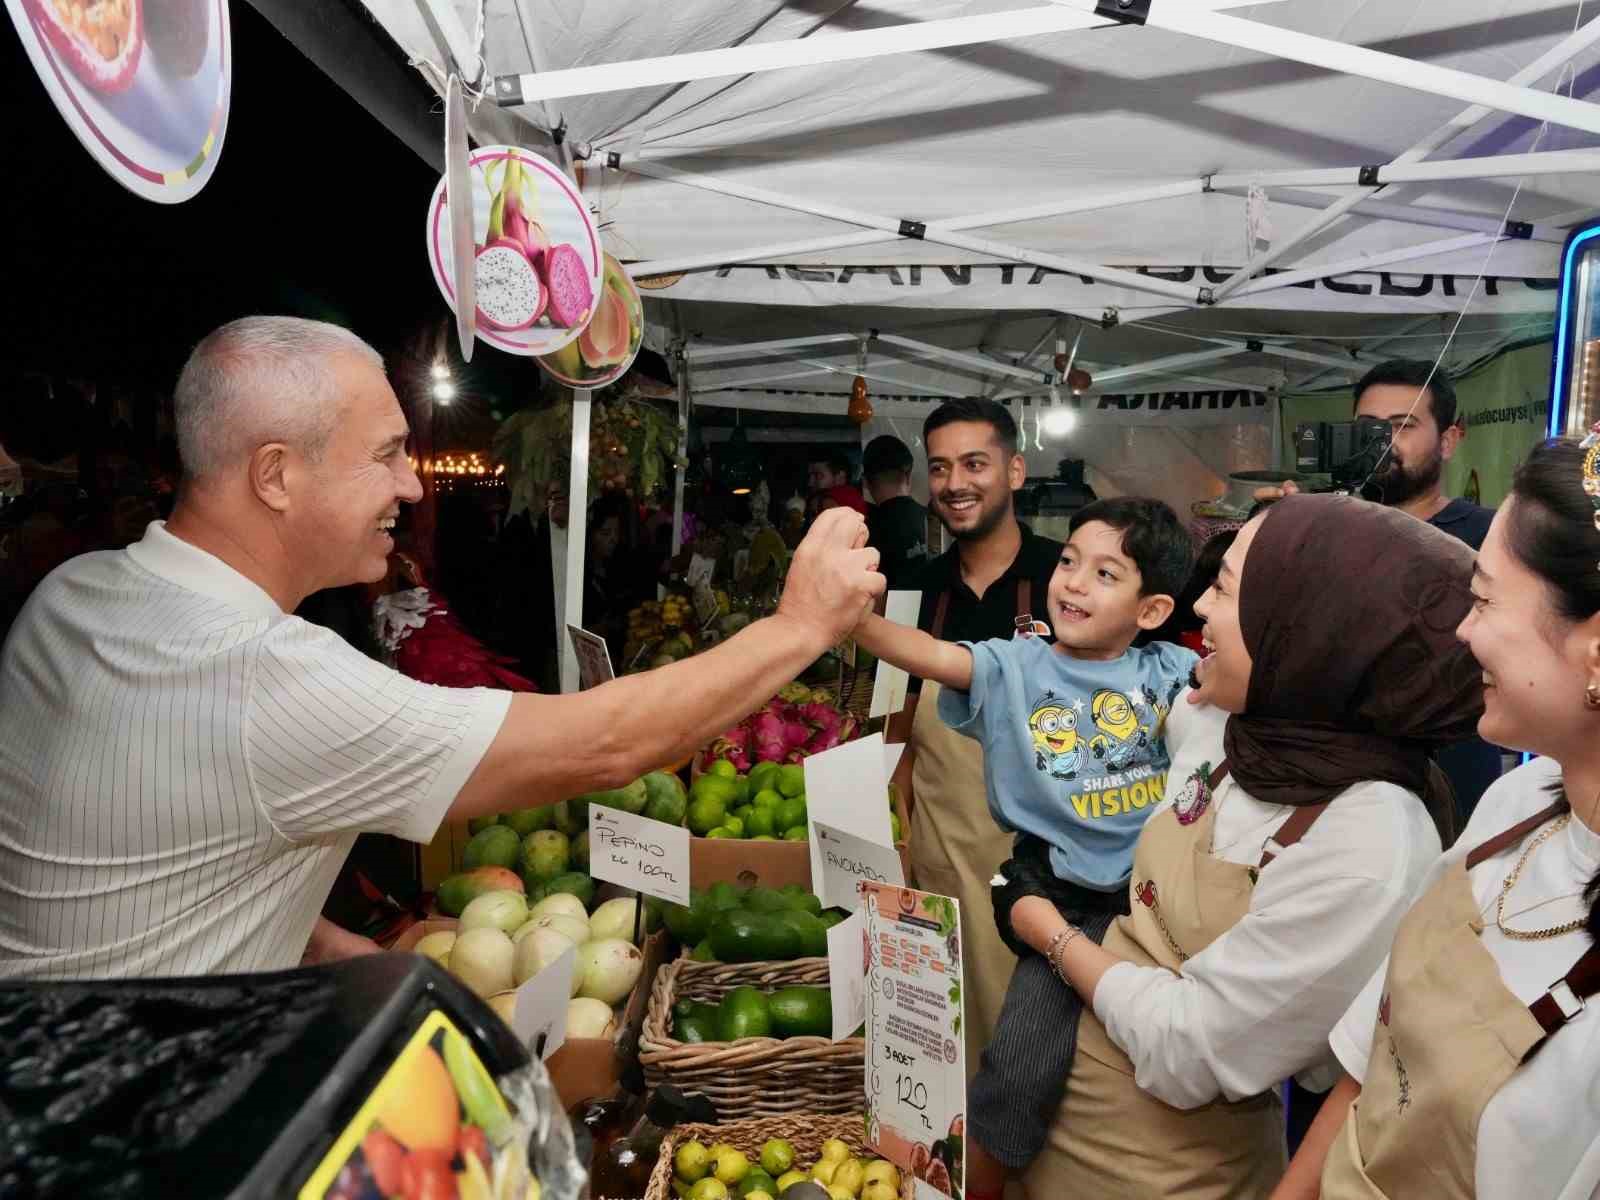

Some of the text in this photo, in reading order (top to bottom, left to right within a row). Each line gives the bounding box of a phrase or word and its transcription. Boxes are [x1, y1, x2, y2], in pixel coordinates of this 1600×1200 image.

[1083, 774, 1125, 792] SHARE
[883, 1044, 892, 1060] 3
[896, 1073, 928, 1111] 120
[920, 1114, 933, 1130] TL
